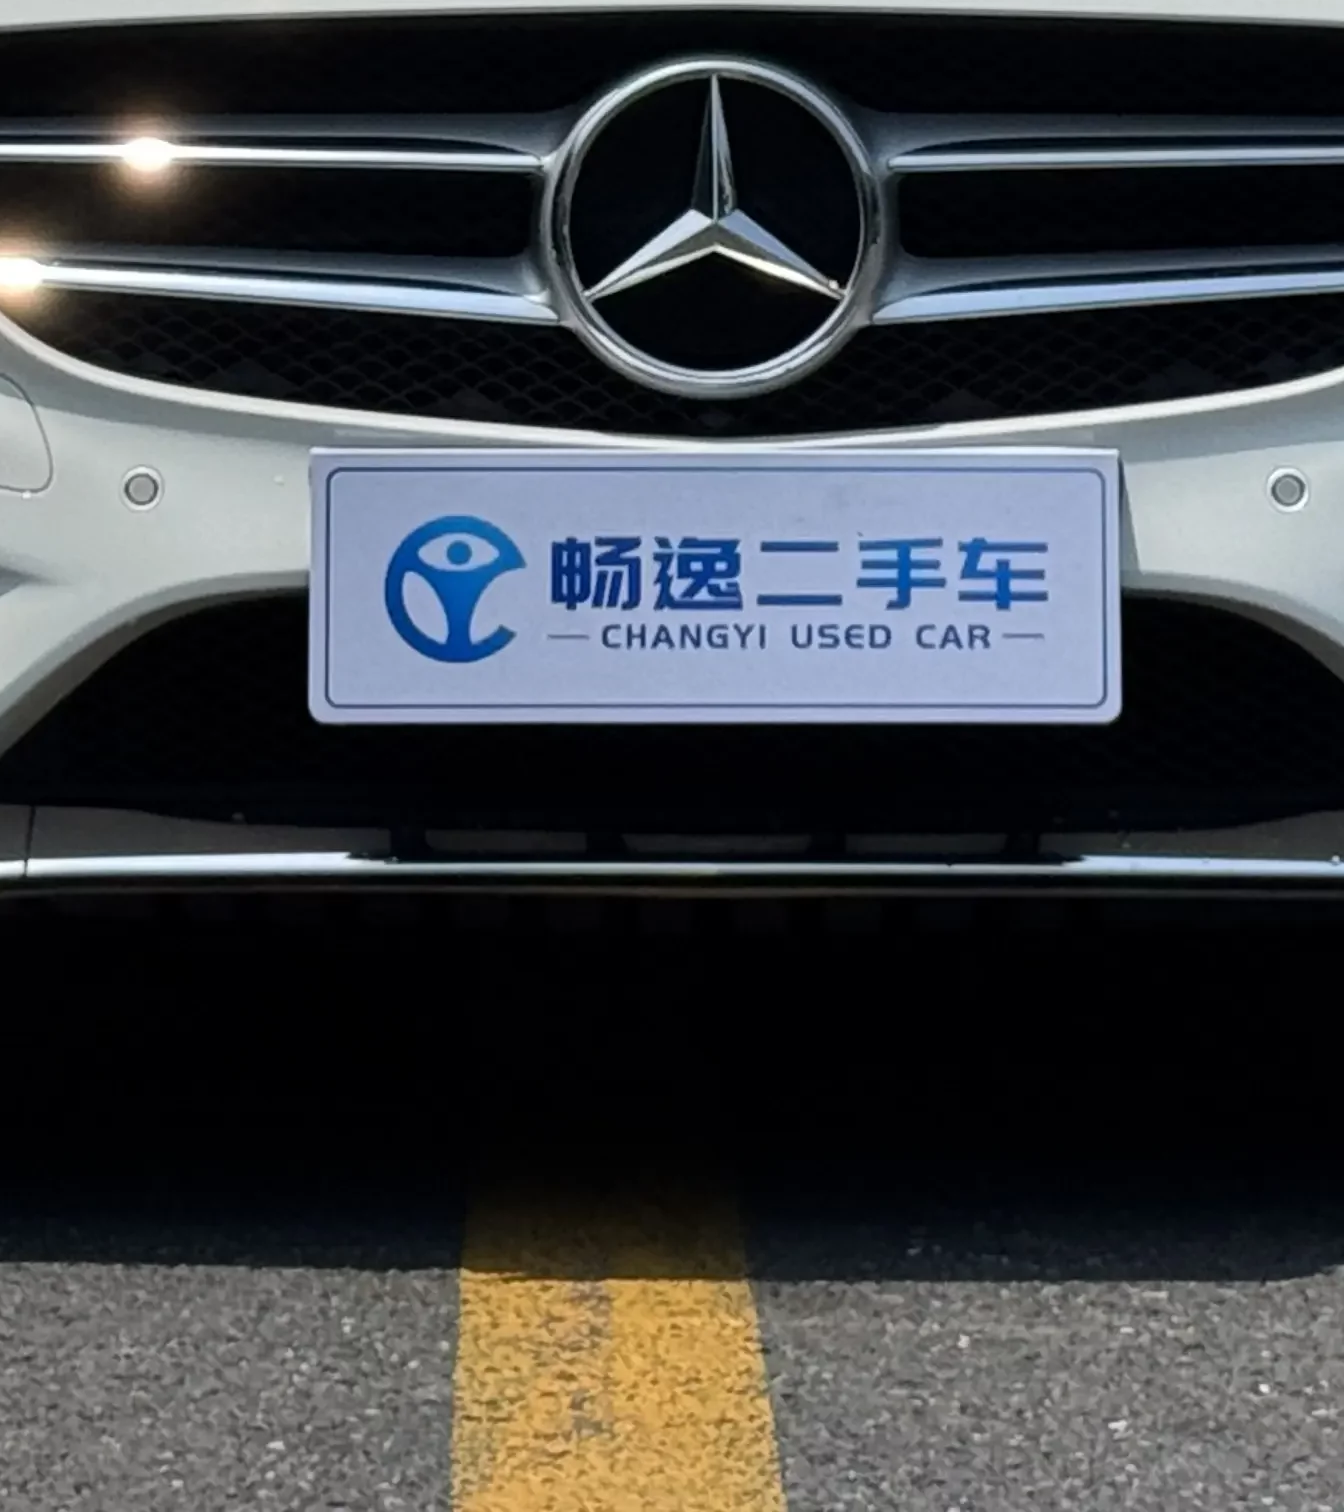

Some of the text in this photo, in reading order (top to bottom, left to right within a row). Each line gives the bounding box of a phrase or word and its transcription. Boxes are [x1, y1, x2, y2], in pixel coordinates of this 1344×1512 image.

[549, 535, 1049, 612] 畅逸二手车
[600, 622, 992, 650] CHANGYI USED CAR
